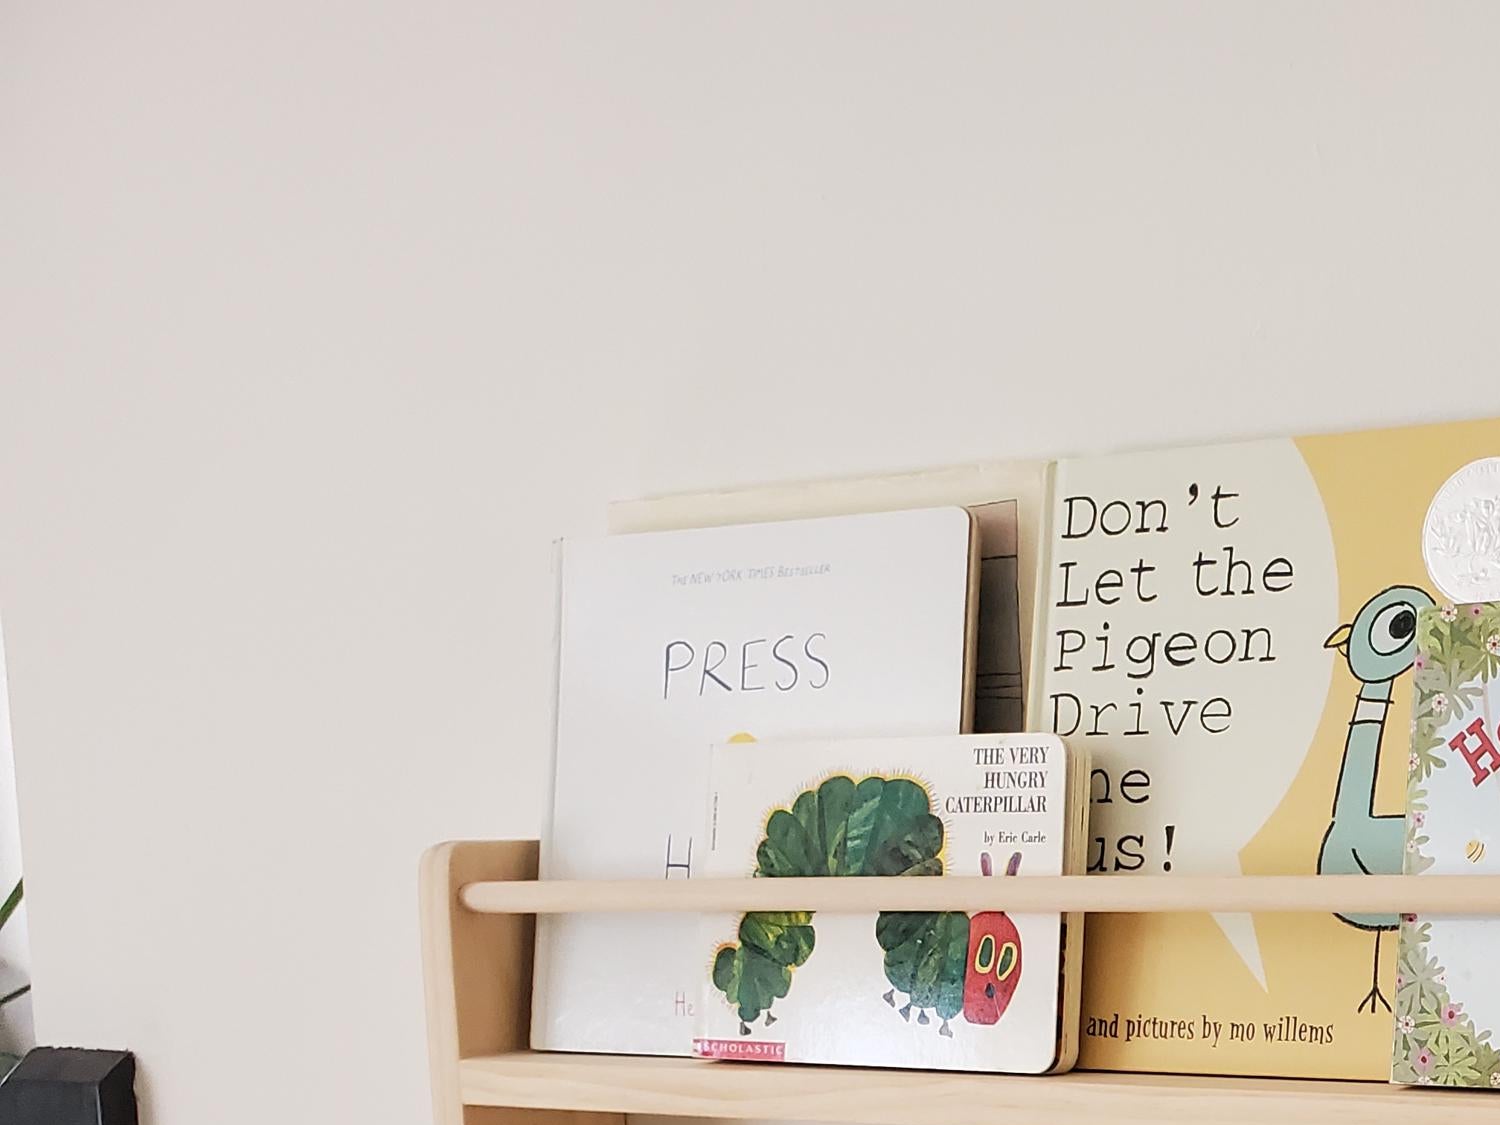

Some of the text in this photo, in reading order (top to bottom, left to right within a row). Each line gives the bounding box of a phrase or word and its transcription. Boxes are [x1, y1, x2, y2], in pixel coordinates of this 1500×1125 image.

[672, 563, 832, 586] THE NEW YORK TIMES BESTSELLER
[1056, 546, 1294, 607] Let the
[1054, 621, 1276, 679] Pigeon
[664, 632, 829, 700] PRESS
[1050, 687, 1233, 737] Drive
[973, 746, 1050, 765] THE VERY
[984, 770, 1049, 789] HUNGRY
[945, 795, 1048, 814] CATERPILLAR
[984, 831, 1047, 846] by Eric Carle
[1087, 825, 1175, 872] us!
[1087, 1013, 1334, 1047] and pictures by mo willems
[703, 1041, 784, 1055] SCHOLASTIC
